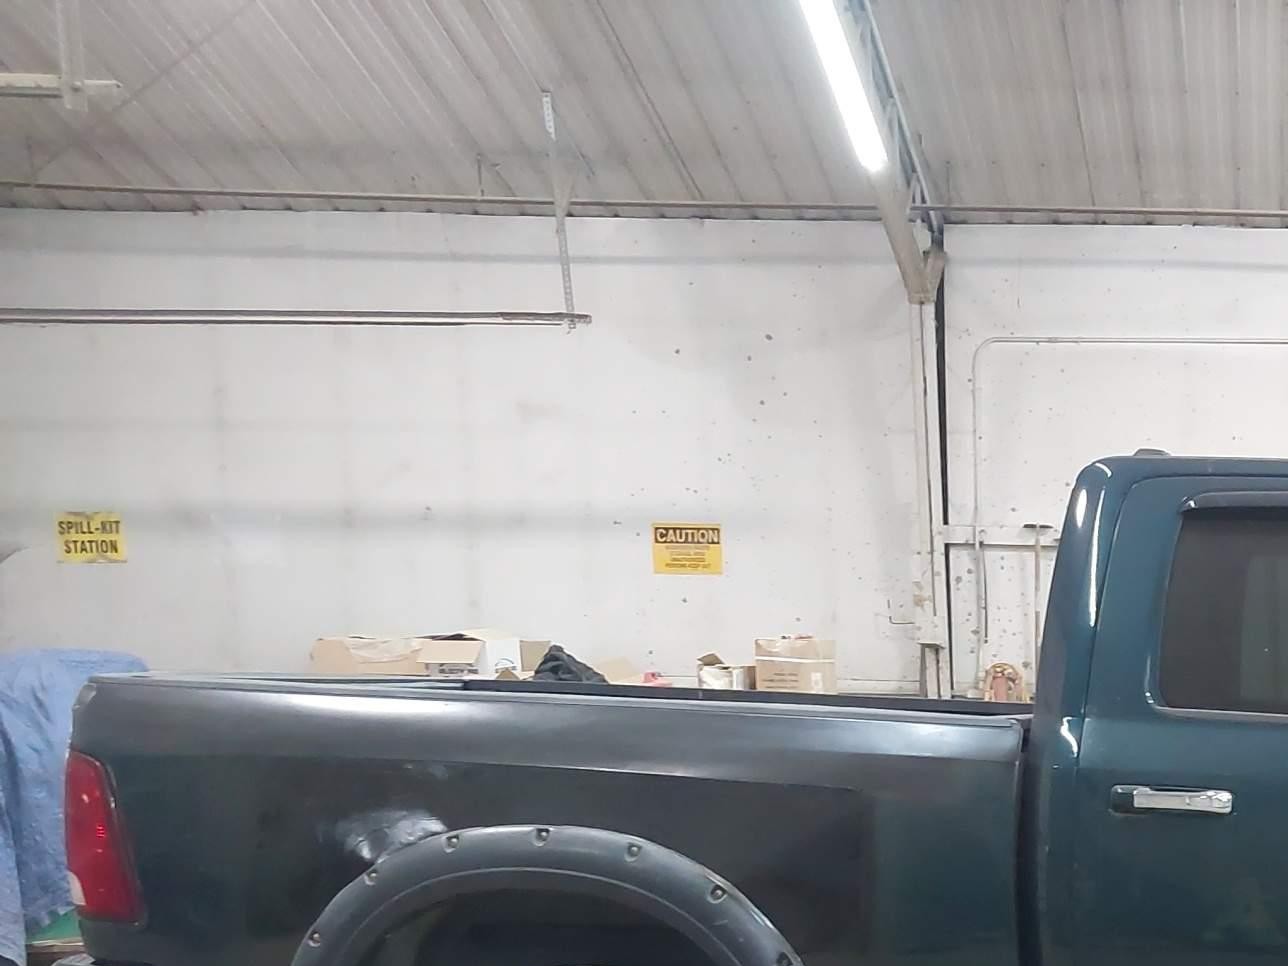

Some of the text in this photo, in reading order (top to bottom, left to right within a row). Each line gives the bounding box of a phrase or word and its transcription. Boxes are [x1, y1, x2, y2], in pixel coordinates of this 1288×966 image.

[57, 520, 121, 535] SPILL-KIT
[656, 528, 719, 542] CAUTION
[64, 540, 118, 554] STATION
